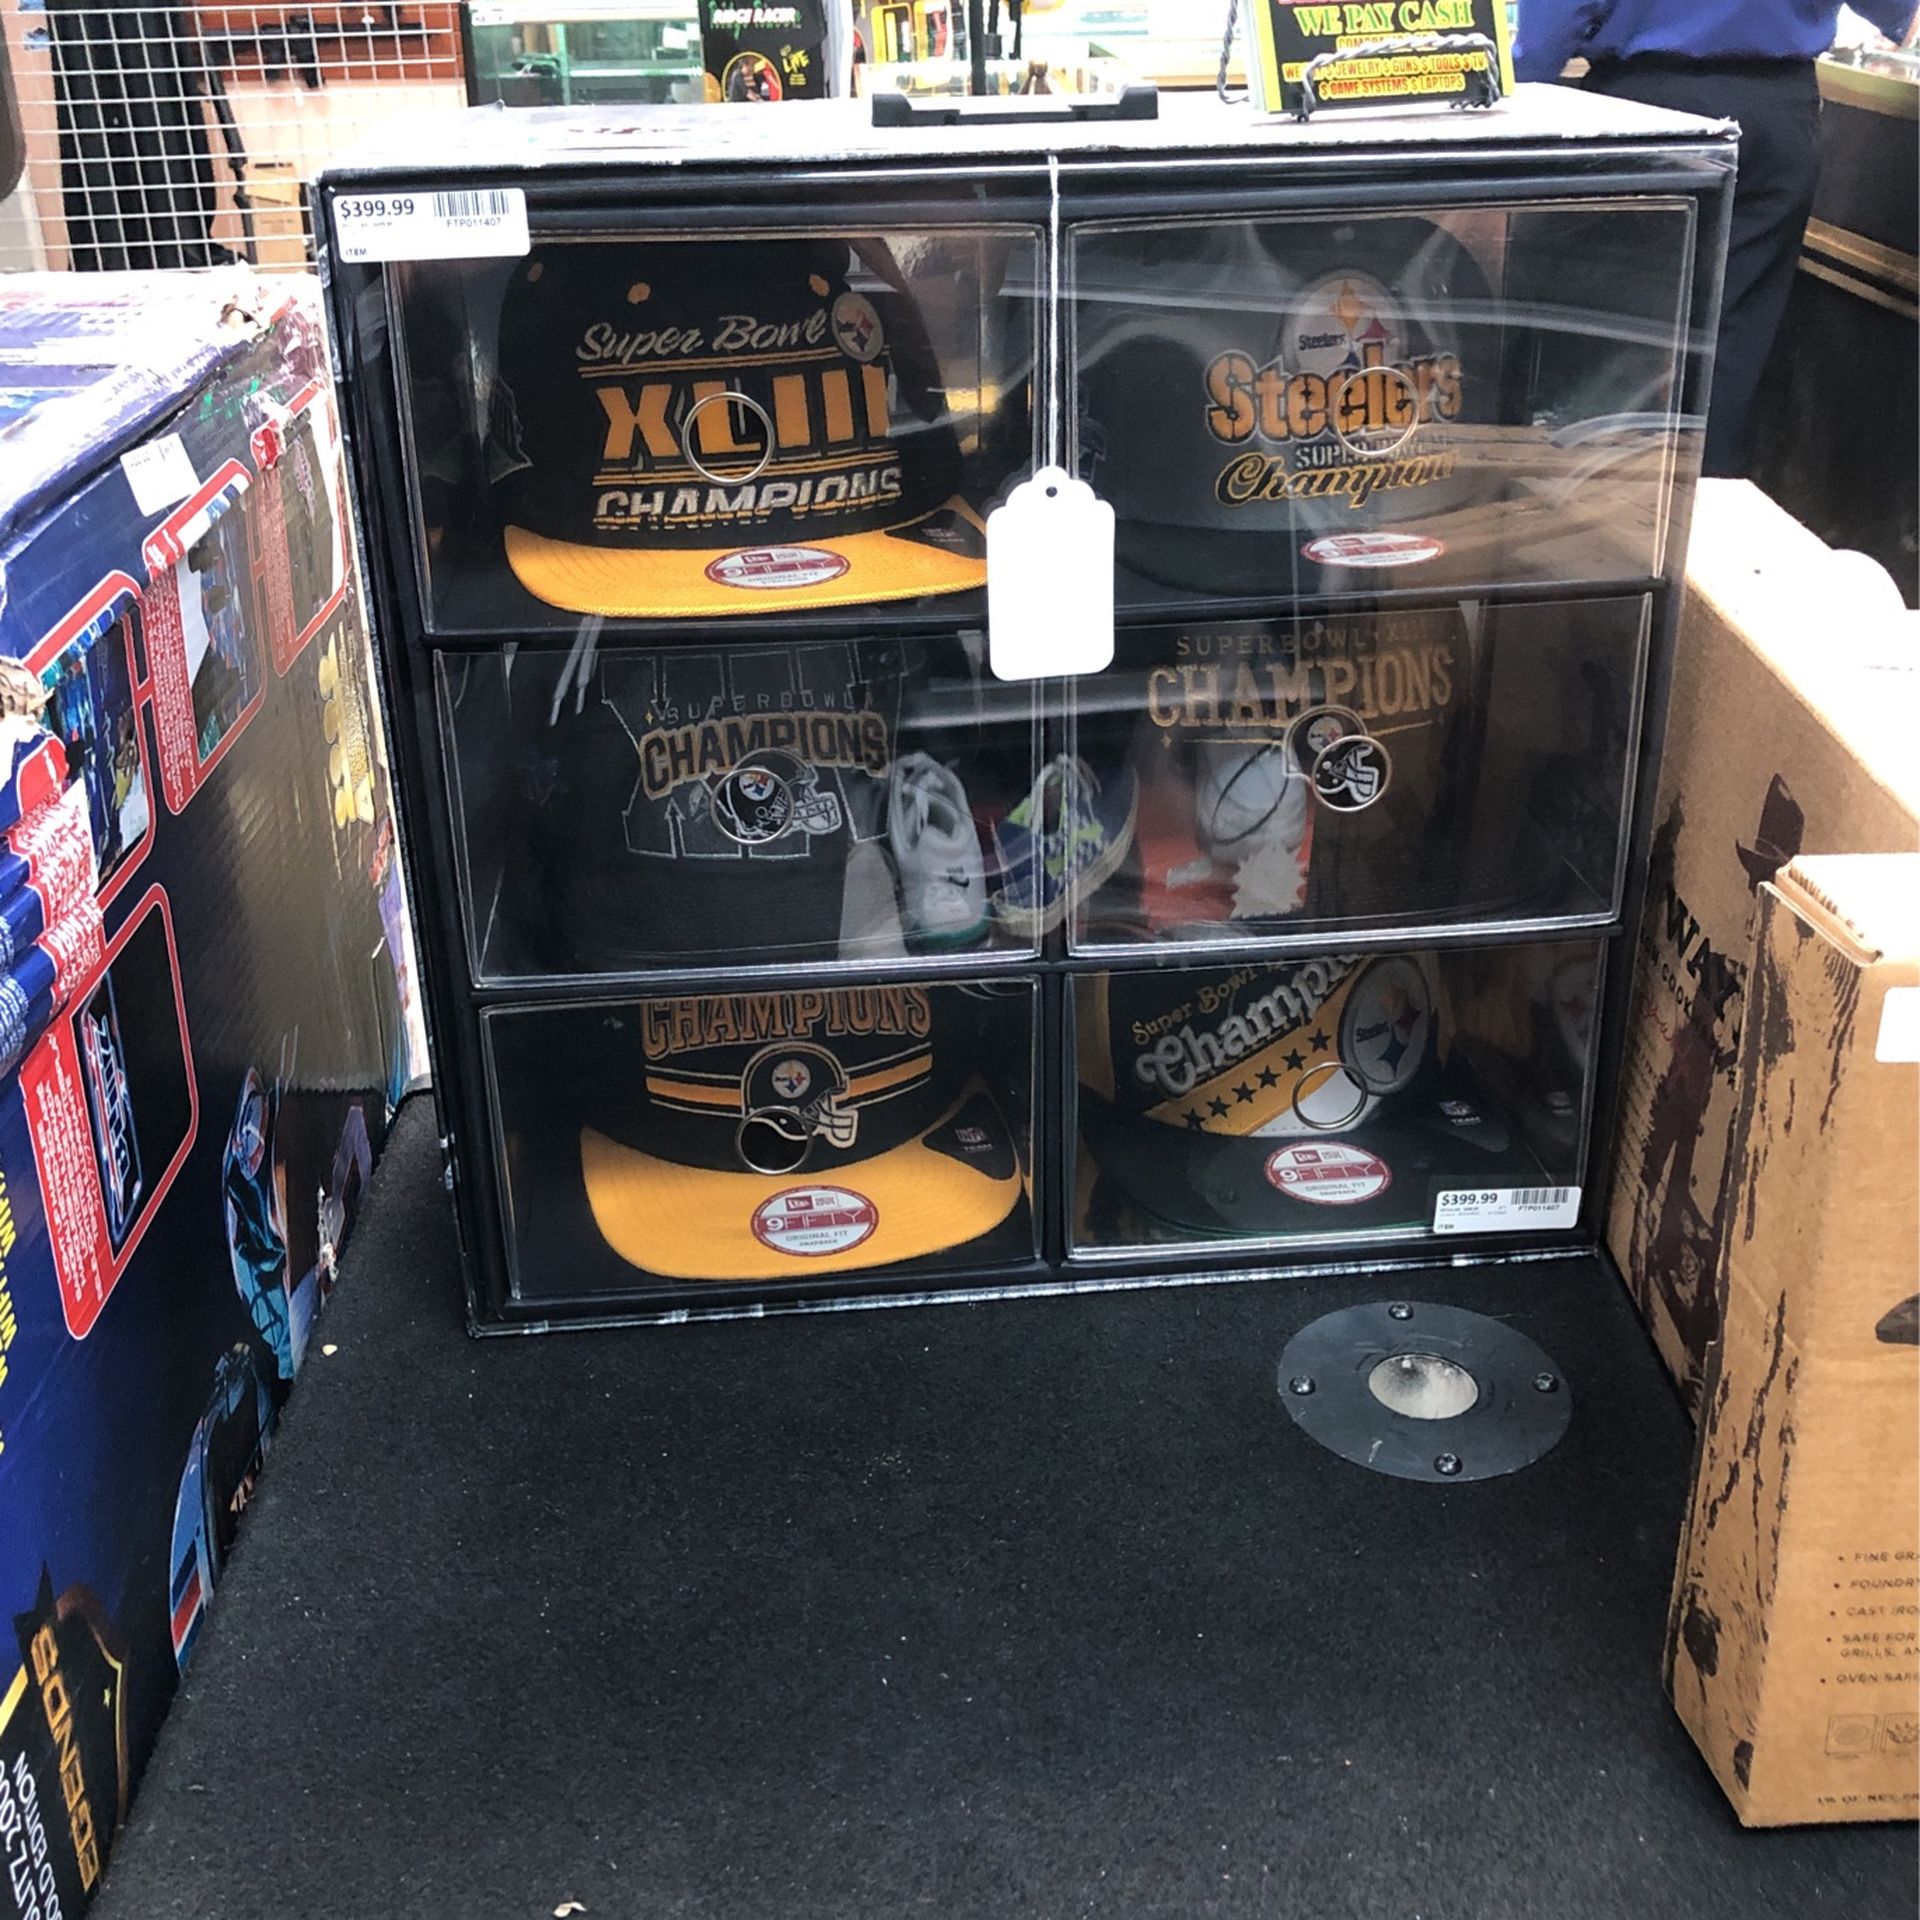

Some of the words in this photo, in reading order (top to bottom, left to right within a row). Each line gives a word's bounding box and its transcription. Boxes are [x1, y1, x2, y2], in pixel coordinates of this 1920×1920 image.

[1294, 6, 1342, 37] WE
[1343, 3, 1396, 34] PAY
[1399, 0, 1475, 31] CASH
[1285, 64, 1300, 78] WE
[1336, 60, 1380, 77] JEWELRY
[1392, 57, 1419, 73] GUNS
[1432, 54, 1461, 71] TOOLS
[1331, 79, 1359, 95] GAME
[1362, 77, 1409, 94] SYSTEMS
[1420, 74, 1463, 90] LAPTOPS
[340, 198, 415, 219] $399.99
[345, 248, 367, 256] ITEM
[575, 312, 704, 365] Super
[712, 308, 827, 351] Bowl
[1298, 332, 1345, 350] Steelers
[1205, 350, 1462, 446] Steelers
[596, 364, 891, 460] XLIII
[595, 466, 903, 524] CHAMPIONS
[1147, 638, 1455, 728] CHAMPIONS
[639, 709, 892, 800] CHAMPIONS
[1131, 1001, 1193, 1047] Super
[1196, 965, 1259, 1015] Bowl
[640, 984, 933, 1061] CHAMPIONS
[1279, 1161, 1377, 1182] 9FIFTY
[1441, 1192, 1498, 1207] $399.99
[765, 1209, 863, 1231] 9FIFTY
[785, 1231, 832, 1241] ORIGINAL
[834, 1229, 848, 1238] FIT
[1853, 1551, 1890, 1563] FINE
[1846, 1606, 1884, 1617] CAST
[1892, 1604, 1919, 1616] IRO
[1842, 1632, 1880, 1644] SAFE
[1836, 1673, 1879, 1685] OVEN
[31, 1622, 99, 1893] EGENDS
[12, 1750, 48, 1869] EDITION
